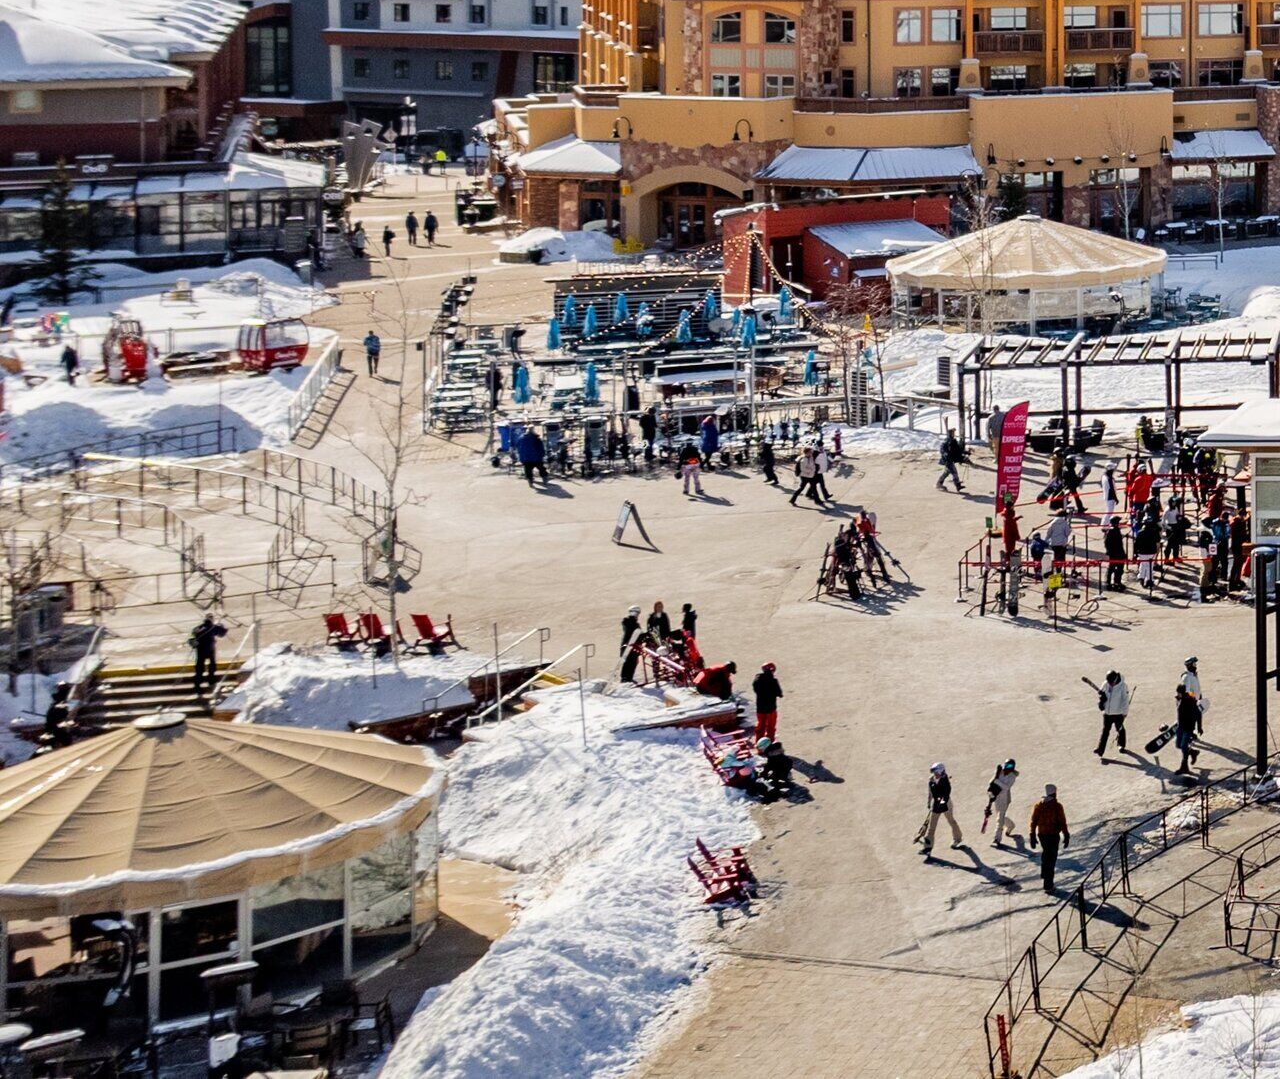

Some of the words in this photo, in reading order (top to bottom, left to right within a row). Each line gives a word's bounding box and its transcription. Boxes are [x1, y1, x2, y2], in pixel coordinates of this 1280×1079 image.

[1002, 435, 1025, 444] EXPRESS
[1013, 445, 1024, 453] LIFT
[1005, 455, 1022, 463] TICKET
